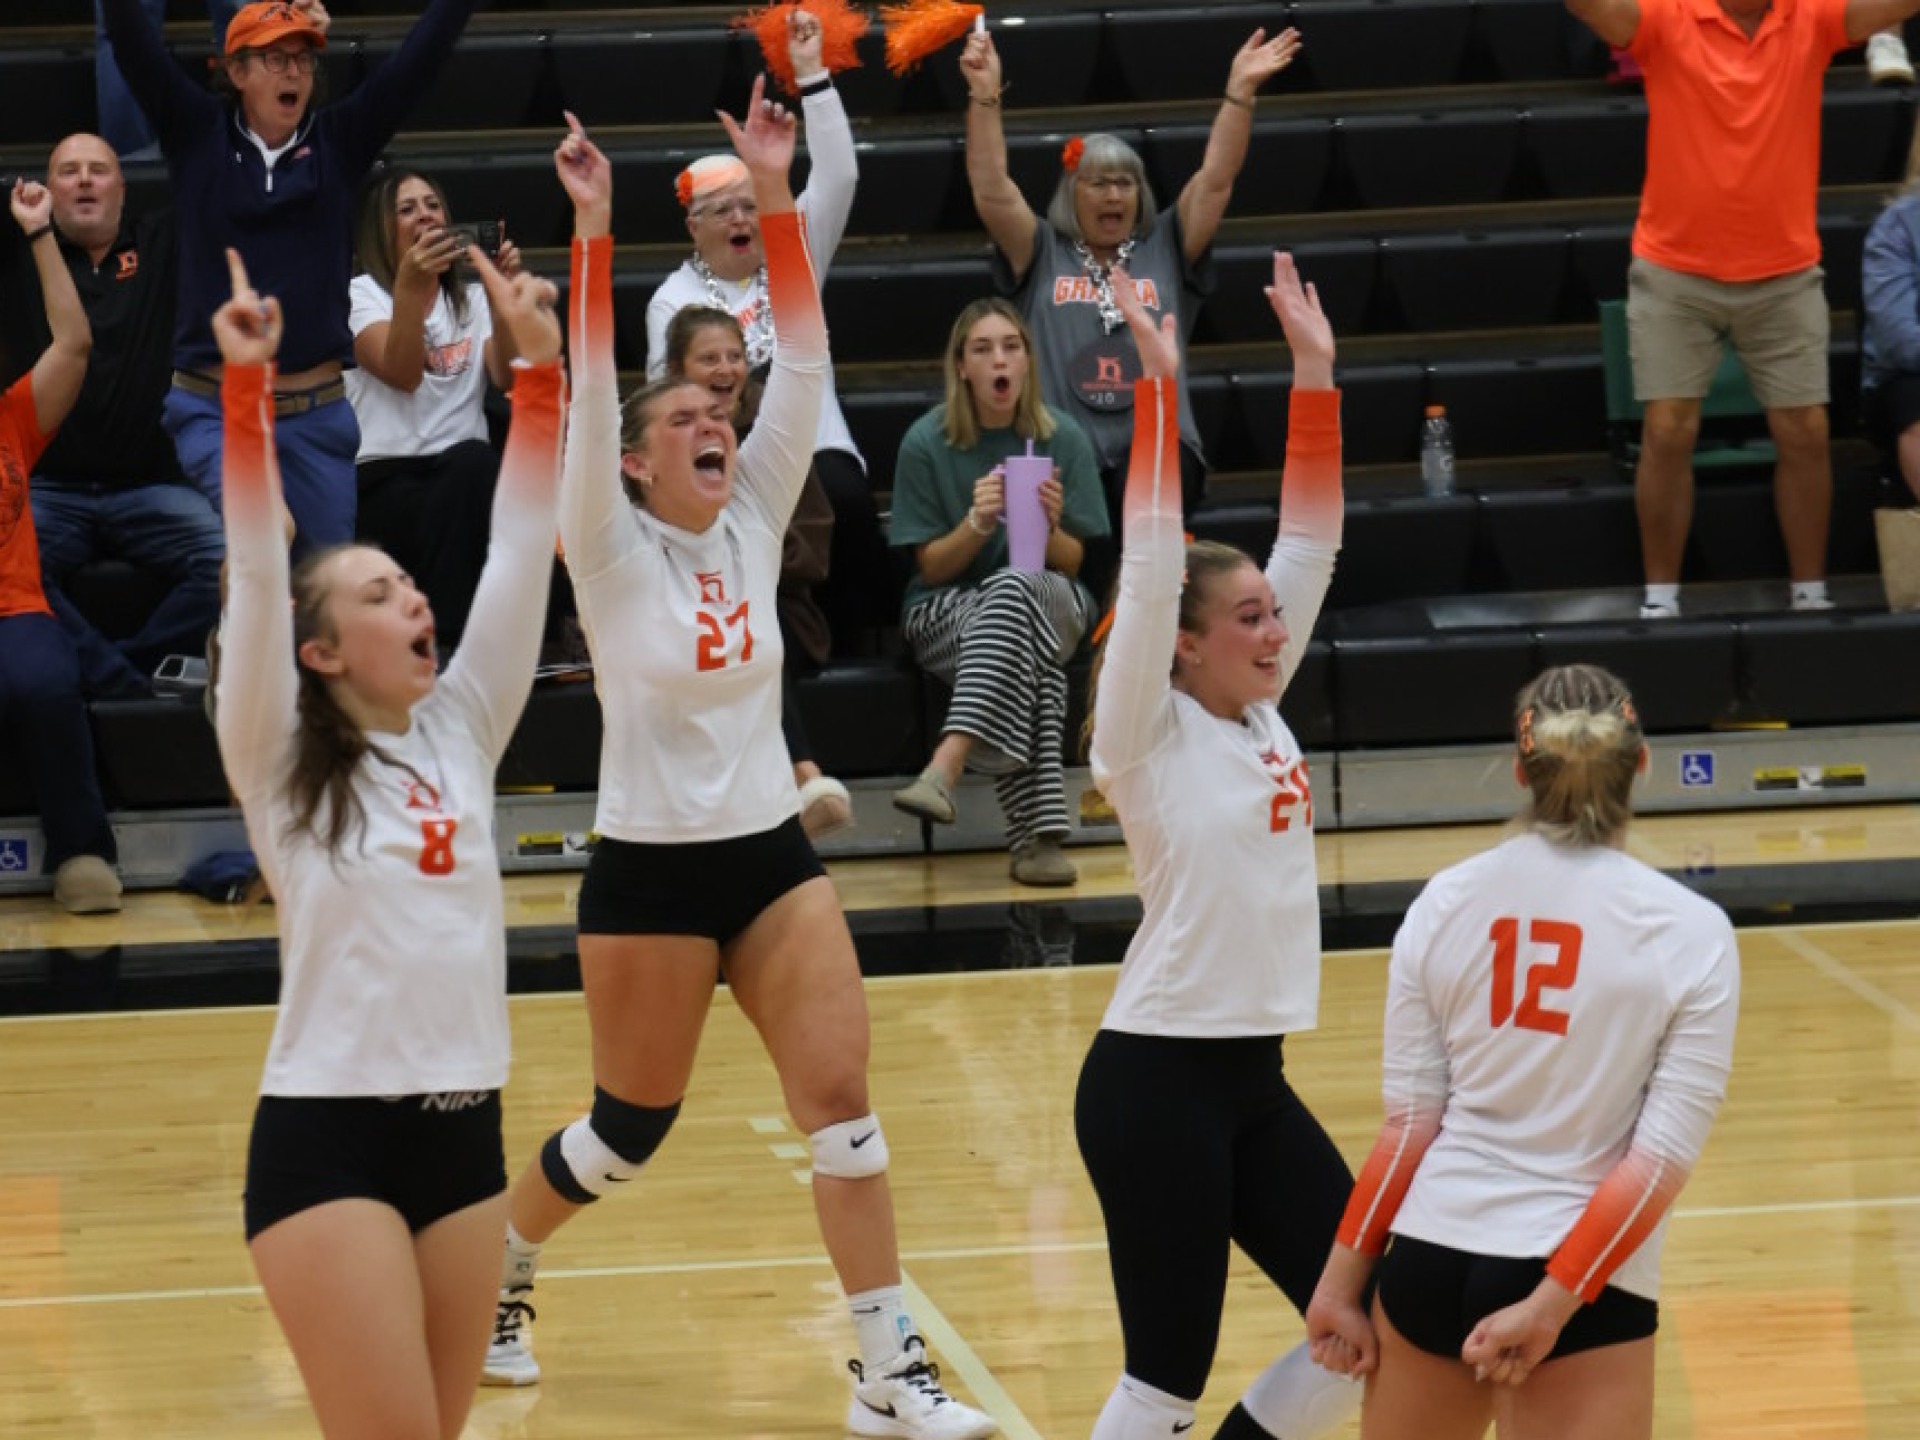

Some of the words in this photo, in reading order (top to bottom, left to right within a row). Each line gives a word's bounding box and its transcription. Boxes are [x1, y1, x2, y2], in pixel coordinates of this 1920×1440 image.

[696, 599, 753, 671] 27
[417, 818, 456, 875] 8
[1488, 917, 1583, 1036] 12
